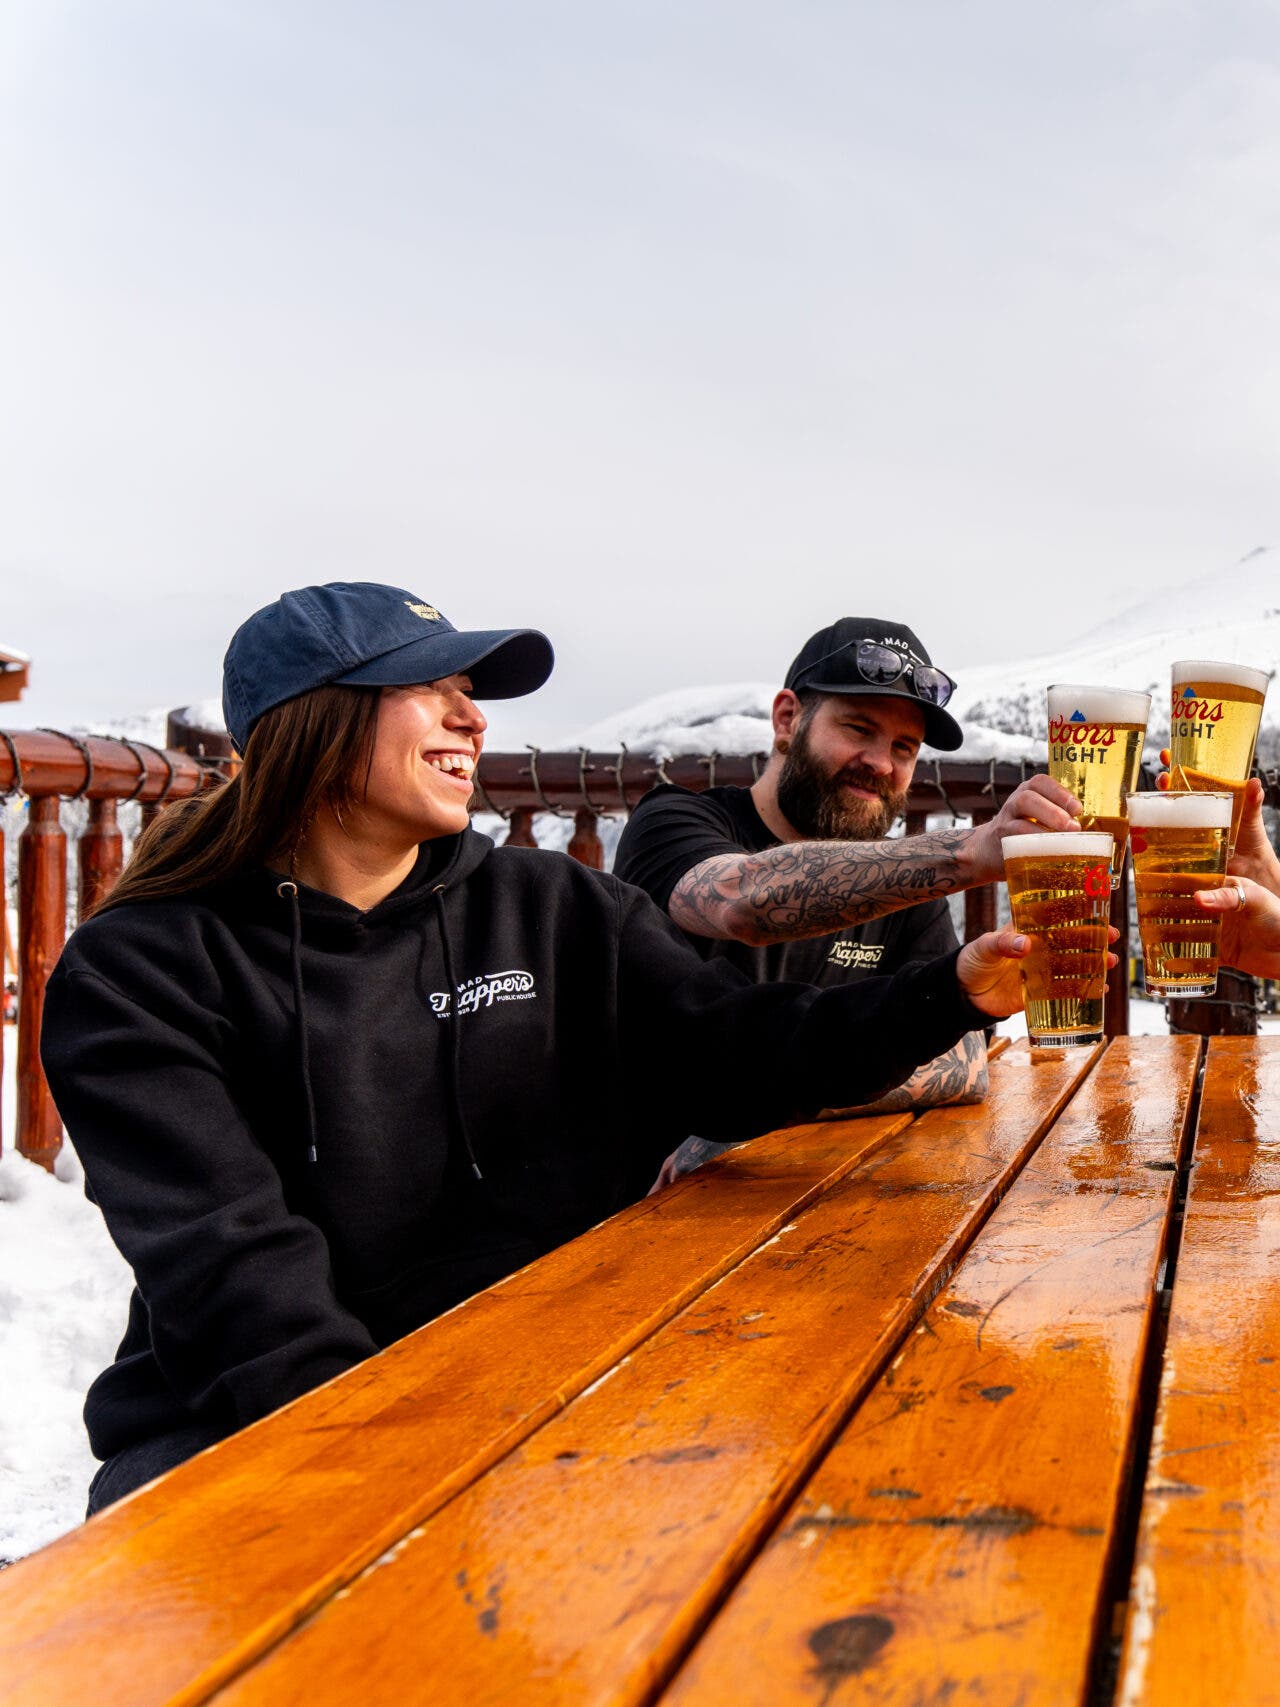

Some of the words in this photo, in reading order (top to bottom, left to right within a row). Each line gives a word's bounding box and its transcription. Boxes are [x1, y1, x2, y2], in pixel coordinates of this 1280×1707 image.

[884, 637, 909, 650] MAD
[1049, 714, 1116, 746] Coors
[1171, 722, 1215, 740] IGHT
[1053, 746, 1108, 764] LIGHT
[429, 970, 535, 1013] Tapper's
[457, 976, 483, 993] MAD
[496, 994, 516, 1002] PUBLIC
[516, 991, 537, 1000] HOUSE
[457, 1007, 471, 1016] 928
